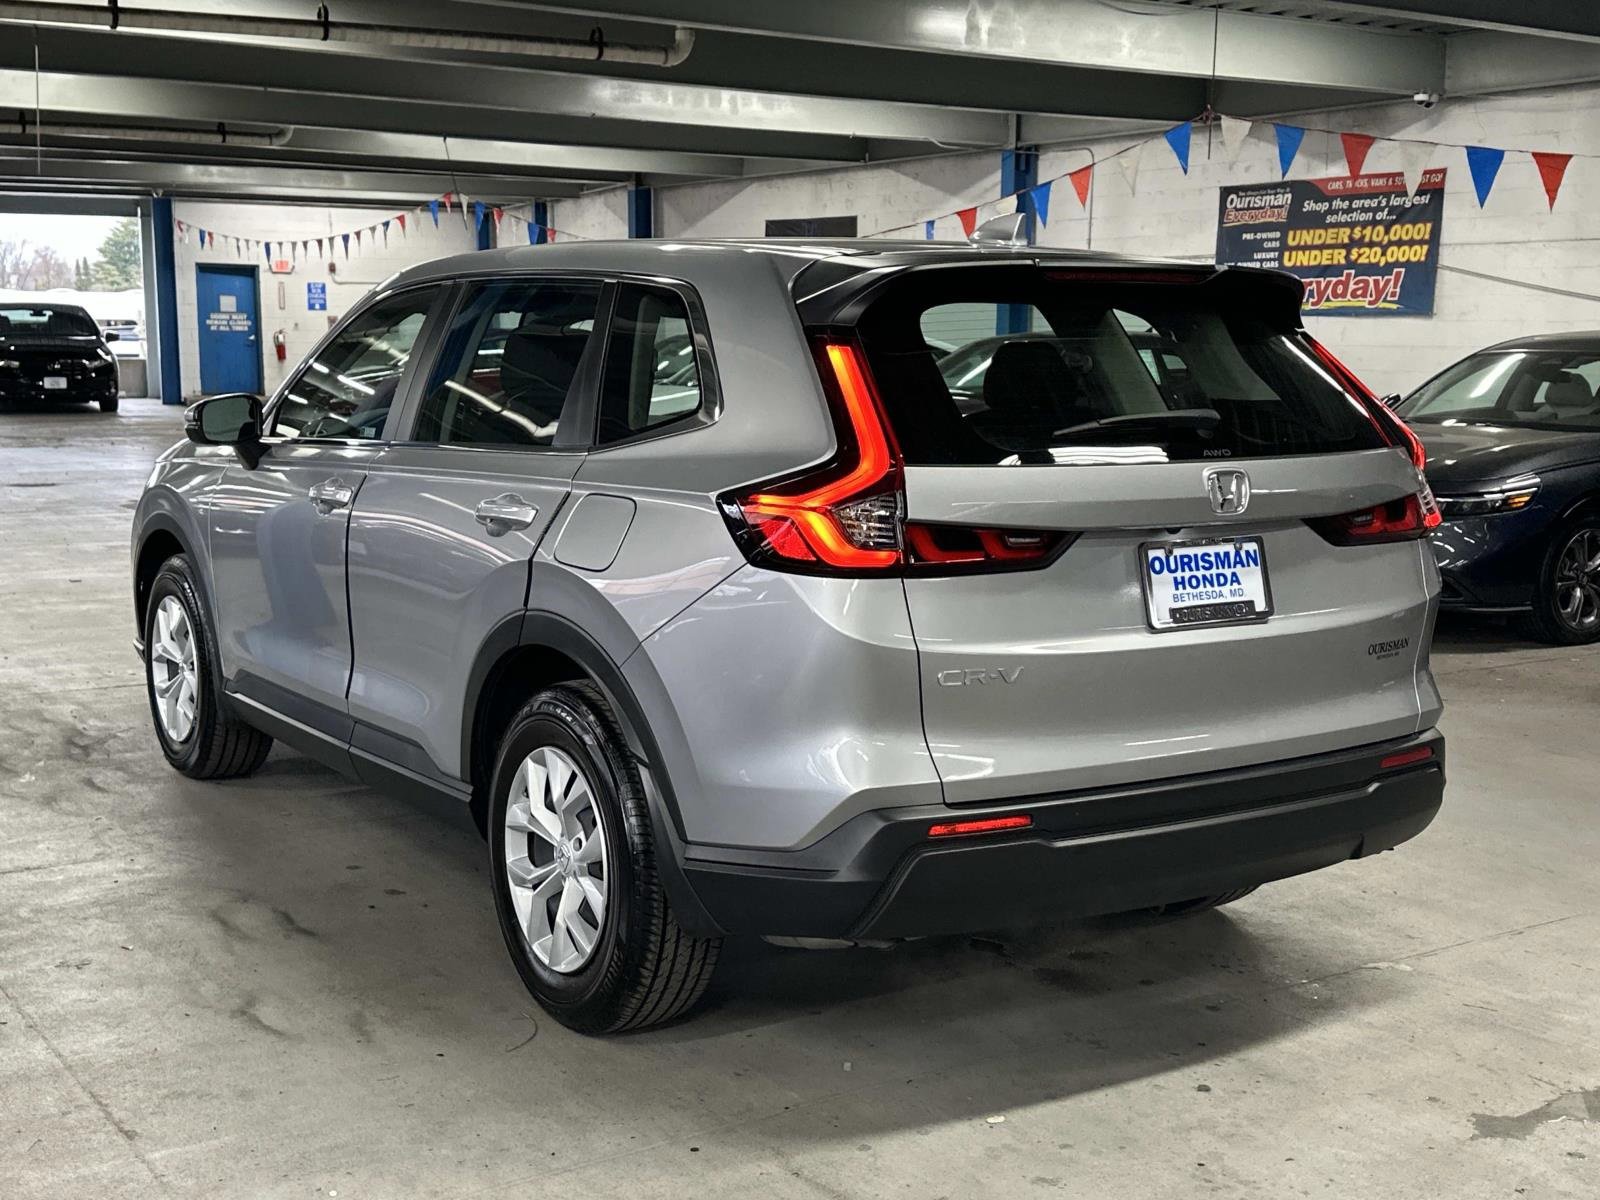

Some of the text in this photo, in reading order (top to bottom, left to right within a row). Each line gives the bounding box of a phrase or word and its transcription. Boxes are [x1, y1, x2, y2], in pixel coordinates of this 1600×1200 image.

[1371, 177, 1387, 187] VANS
[1226, 193, 1292, 209] Ourisman
[1302, 193, 1431, 213] Shop the area's largest
[1224, 205, 1289, 222] Everyday!
[1325, 208, 1397, 223] selection of...
[1242, 231, 1281, 240] PRE-OWNED
[1287, 223, 1432, 246] UNDER $10,000!
[1263, 240, 1281, 248] CARS
[1253, 251, 1279, 260] LUXURY
[1283, 245, 1429, 267] UNDER $20,000!
[1262, 260, 1279, 268] CARS
[1302, 268, 1405, 308] ryday!
[1203, 448, 1231, 457] AWD
[1149, 549, 1259, 575] OURISMAN
[1173, 572, 1241, 591] HONDA
[1172, 588, 1244, 603] BETHESDA, MD
[1368, 637, 1410, 656] OURISMAN
[937, 666, 1025, 686] CR-V
